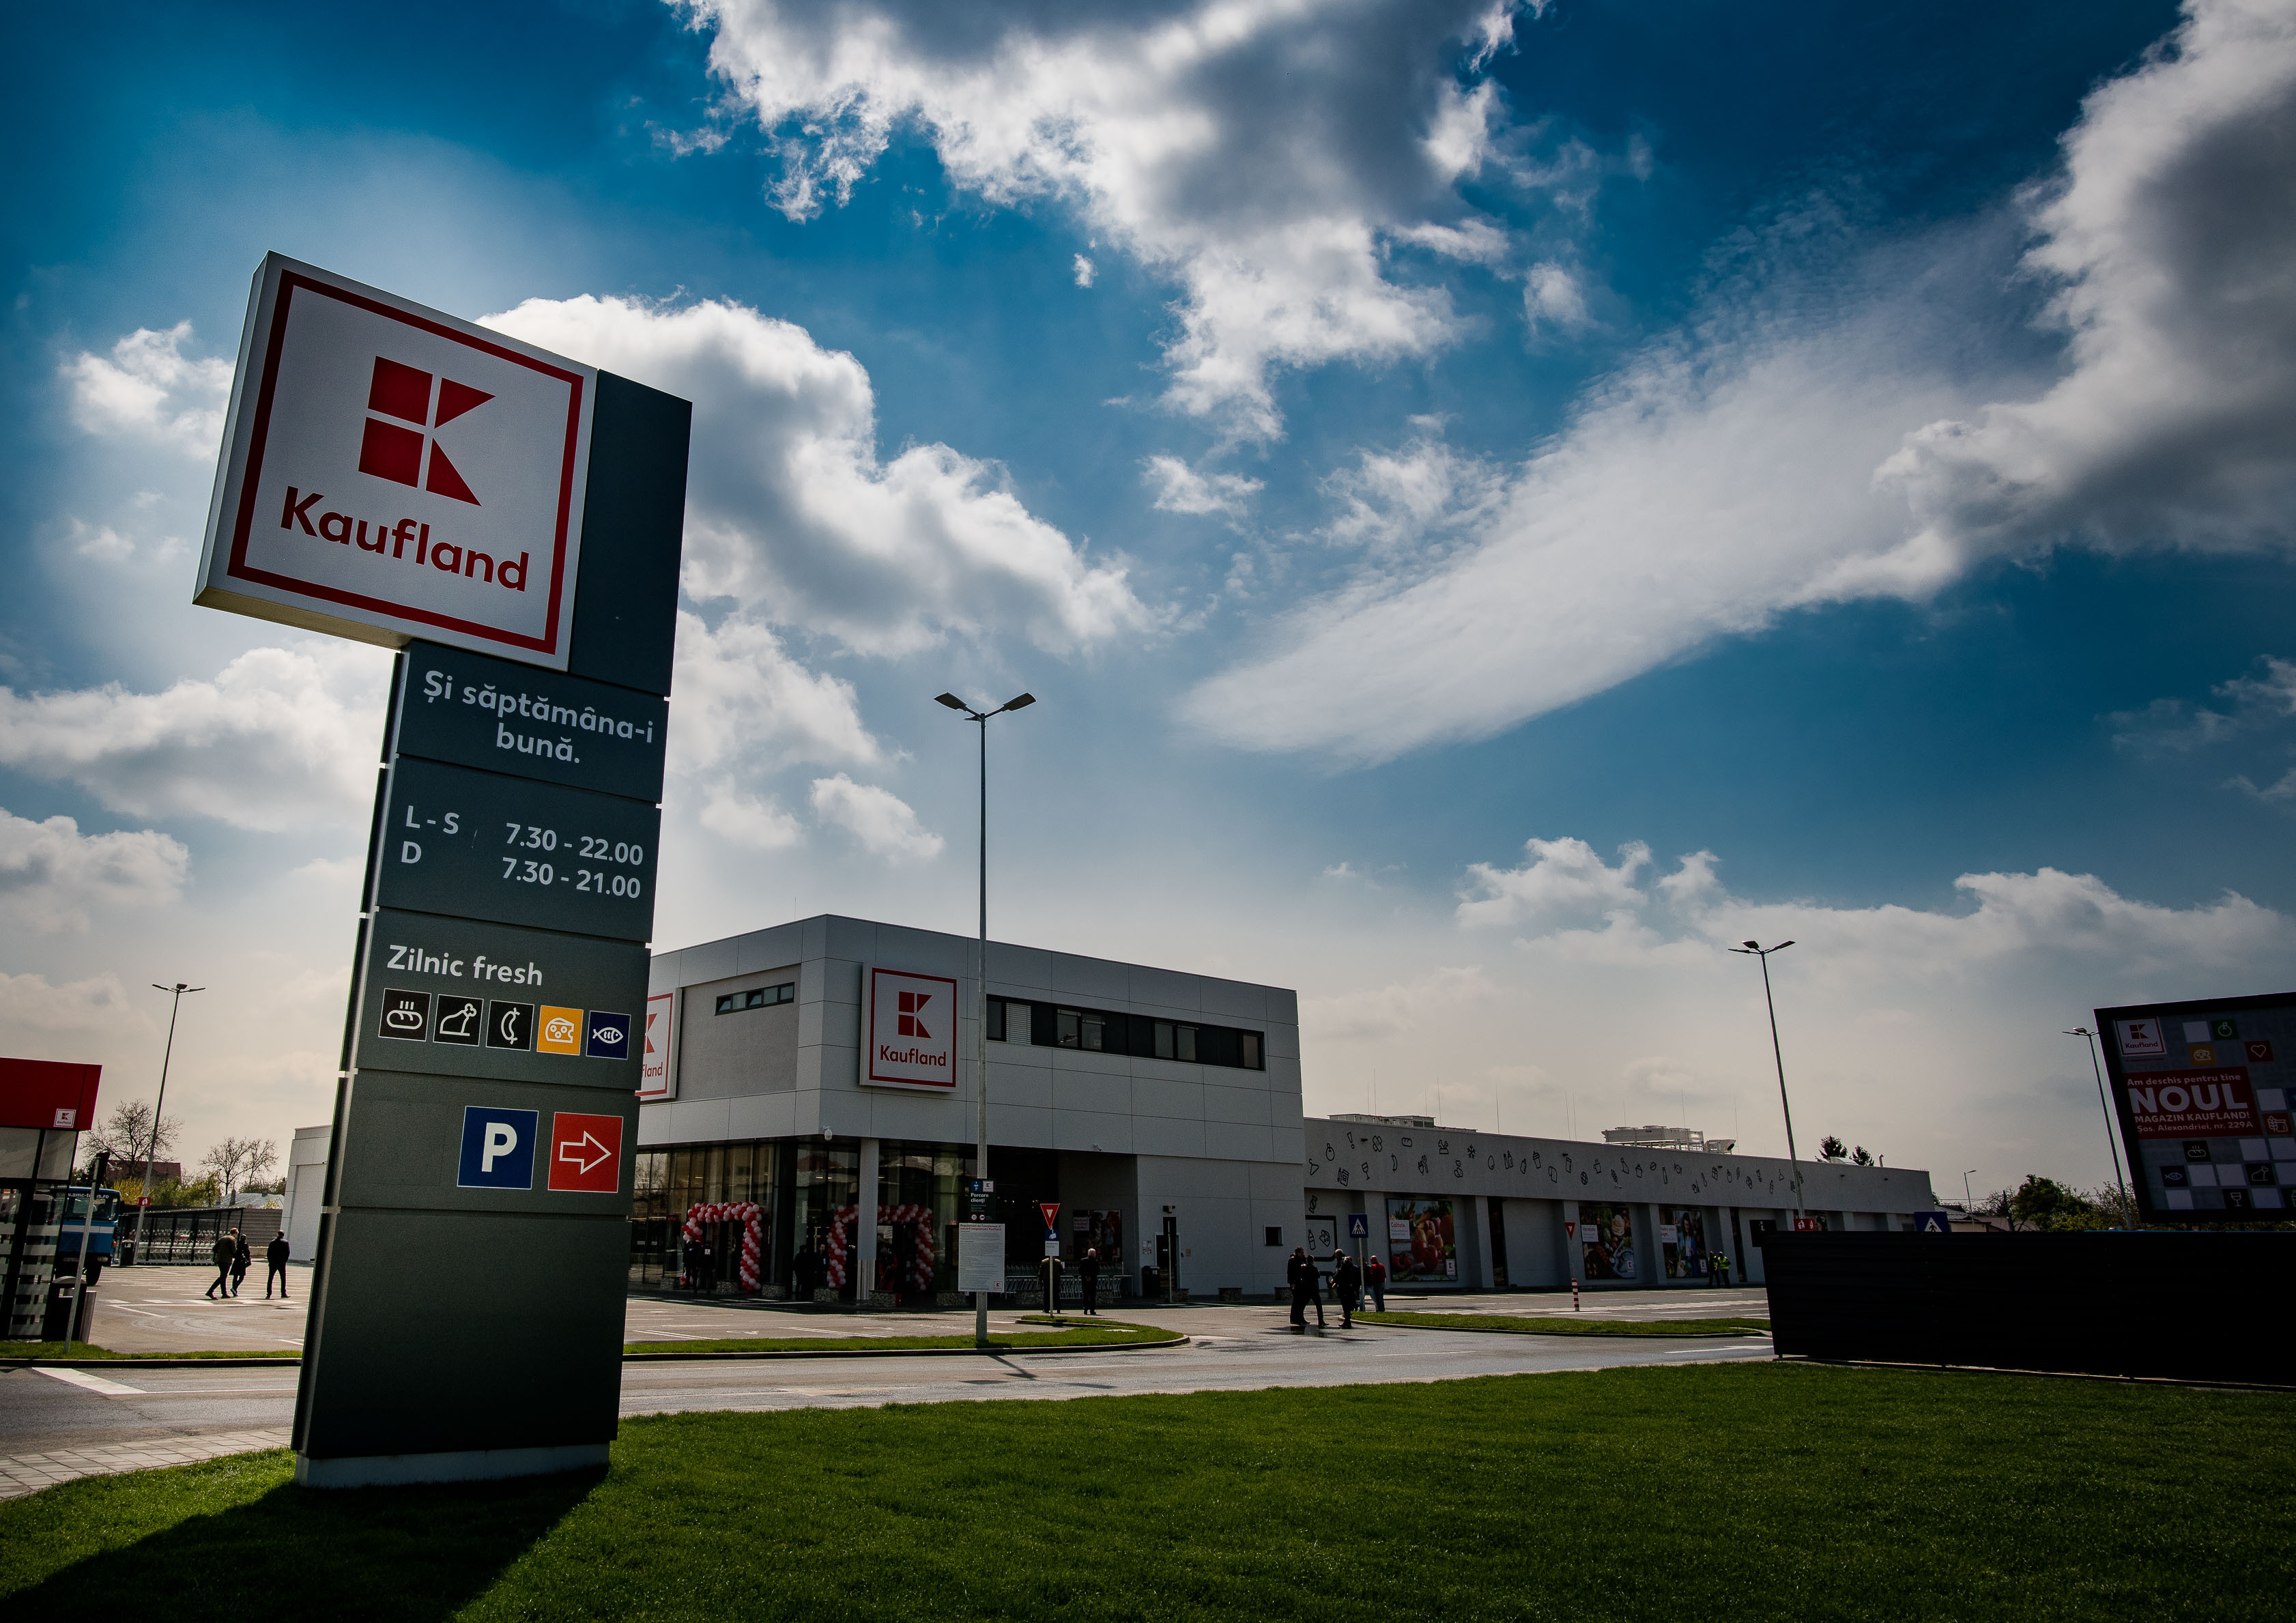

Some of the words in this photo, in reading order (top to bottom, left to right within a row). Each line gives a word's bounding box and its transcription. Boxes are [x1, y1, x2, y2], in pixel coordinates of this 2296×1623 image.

[280, 486, 530, 592] Kaufland
[423, 670, 453, 702] Și
[462, 684, 653, 743] săptămâna-i
[496, 722, 579, 764] bună.
[405, 805, 420, 829] L
[442, 812, 459, 834] S
[506, 822, 557, 851] 7.30
[579, 836, 643, 865] 22.00
[401, 841, 422, 864] D
[502, 857, 554, 885] 7.30
[576, 870, 640, 898] 21.00
[387, 944, 464, 977] Zilnic
[473, 956, 543, 986] fresh
[880, 1044, 946, 1066] Kaufland
[2127, 1078, 2144, 1087] Am
[2146, 1076, 2182, 1085] deschis
[2184, 1075, 2218, 1085] pentru
[2128, 1083, 2249, 1113] NOUL
[2135, 1114, 2185, 1123] MAGAZIN
[2186, 1111, 2250, 1121] KAUFLAND!
[2137, 1125, 2156, 1134] Șos.
[2158, 1123, 2212, 1131] Alexandriei,
[482, 1122, 517, 1173] P
